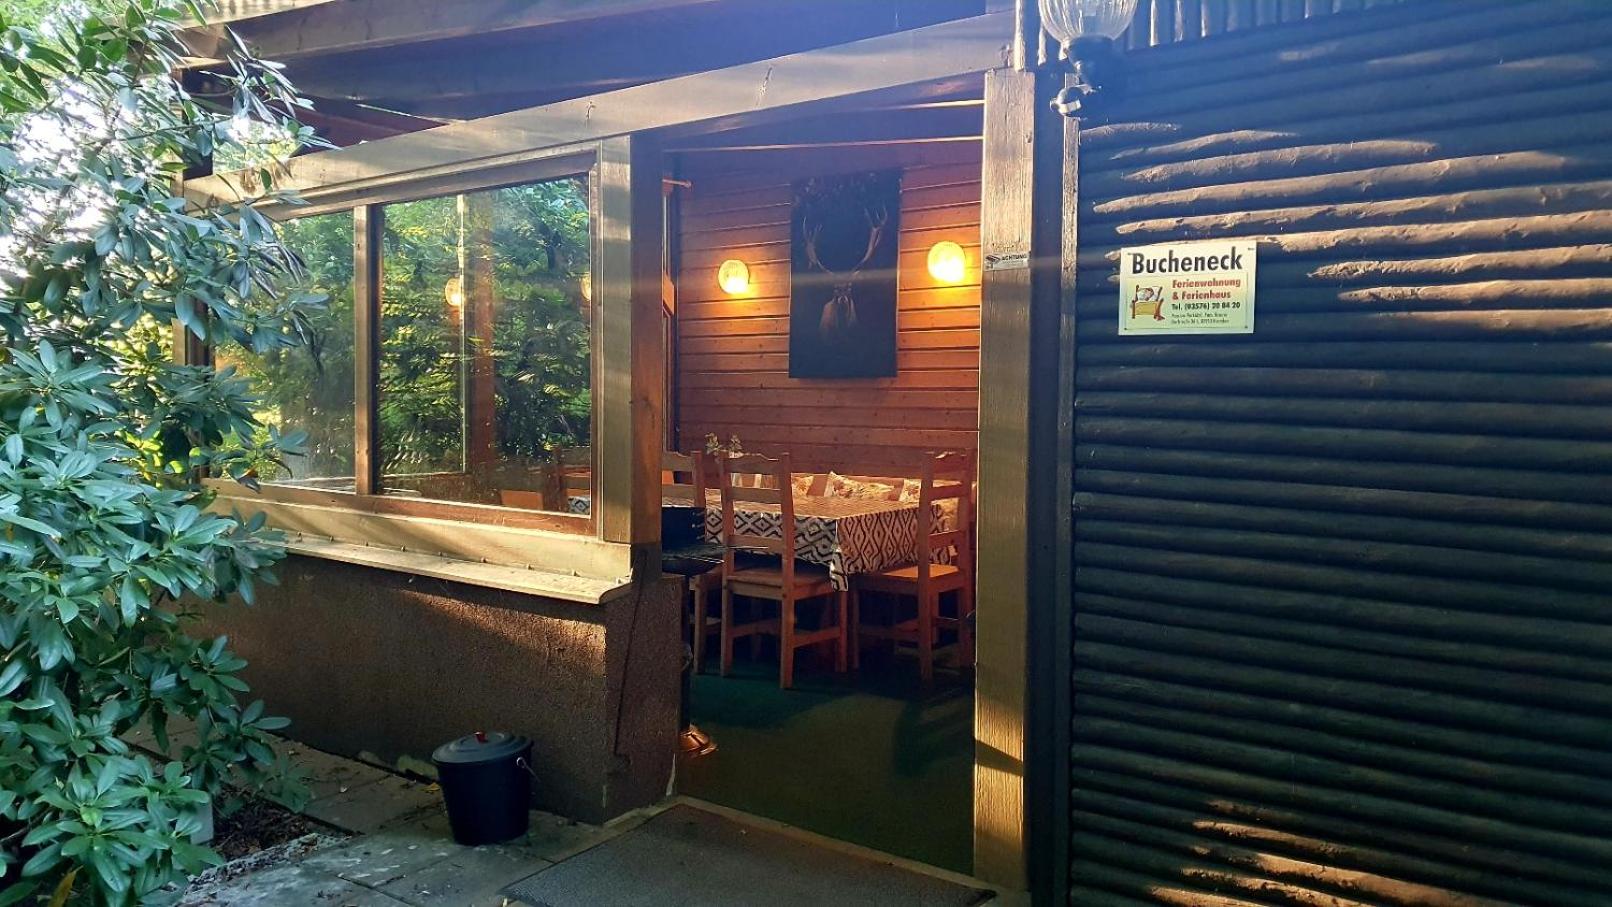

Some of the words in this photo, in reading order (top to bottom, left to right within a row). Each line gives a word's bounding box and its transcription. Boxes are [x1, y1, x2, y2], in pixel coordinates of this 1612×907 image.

[1132, 246, 1243, 274] Bucheneck
[1172, 278, 1241, 289] Ferienwohnung
[1182, 290, 1231, 300] Ferienhaus
[1172, 303, 1183, 311] Tel.
